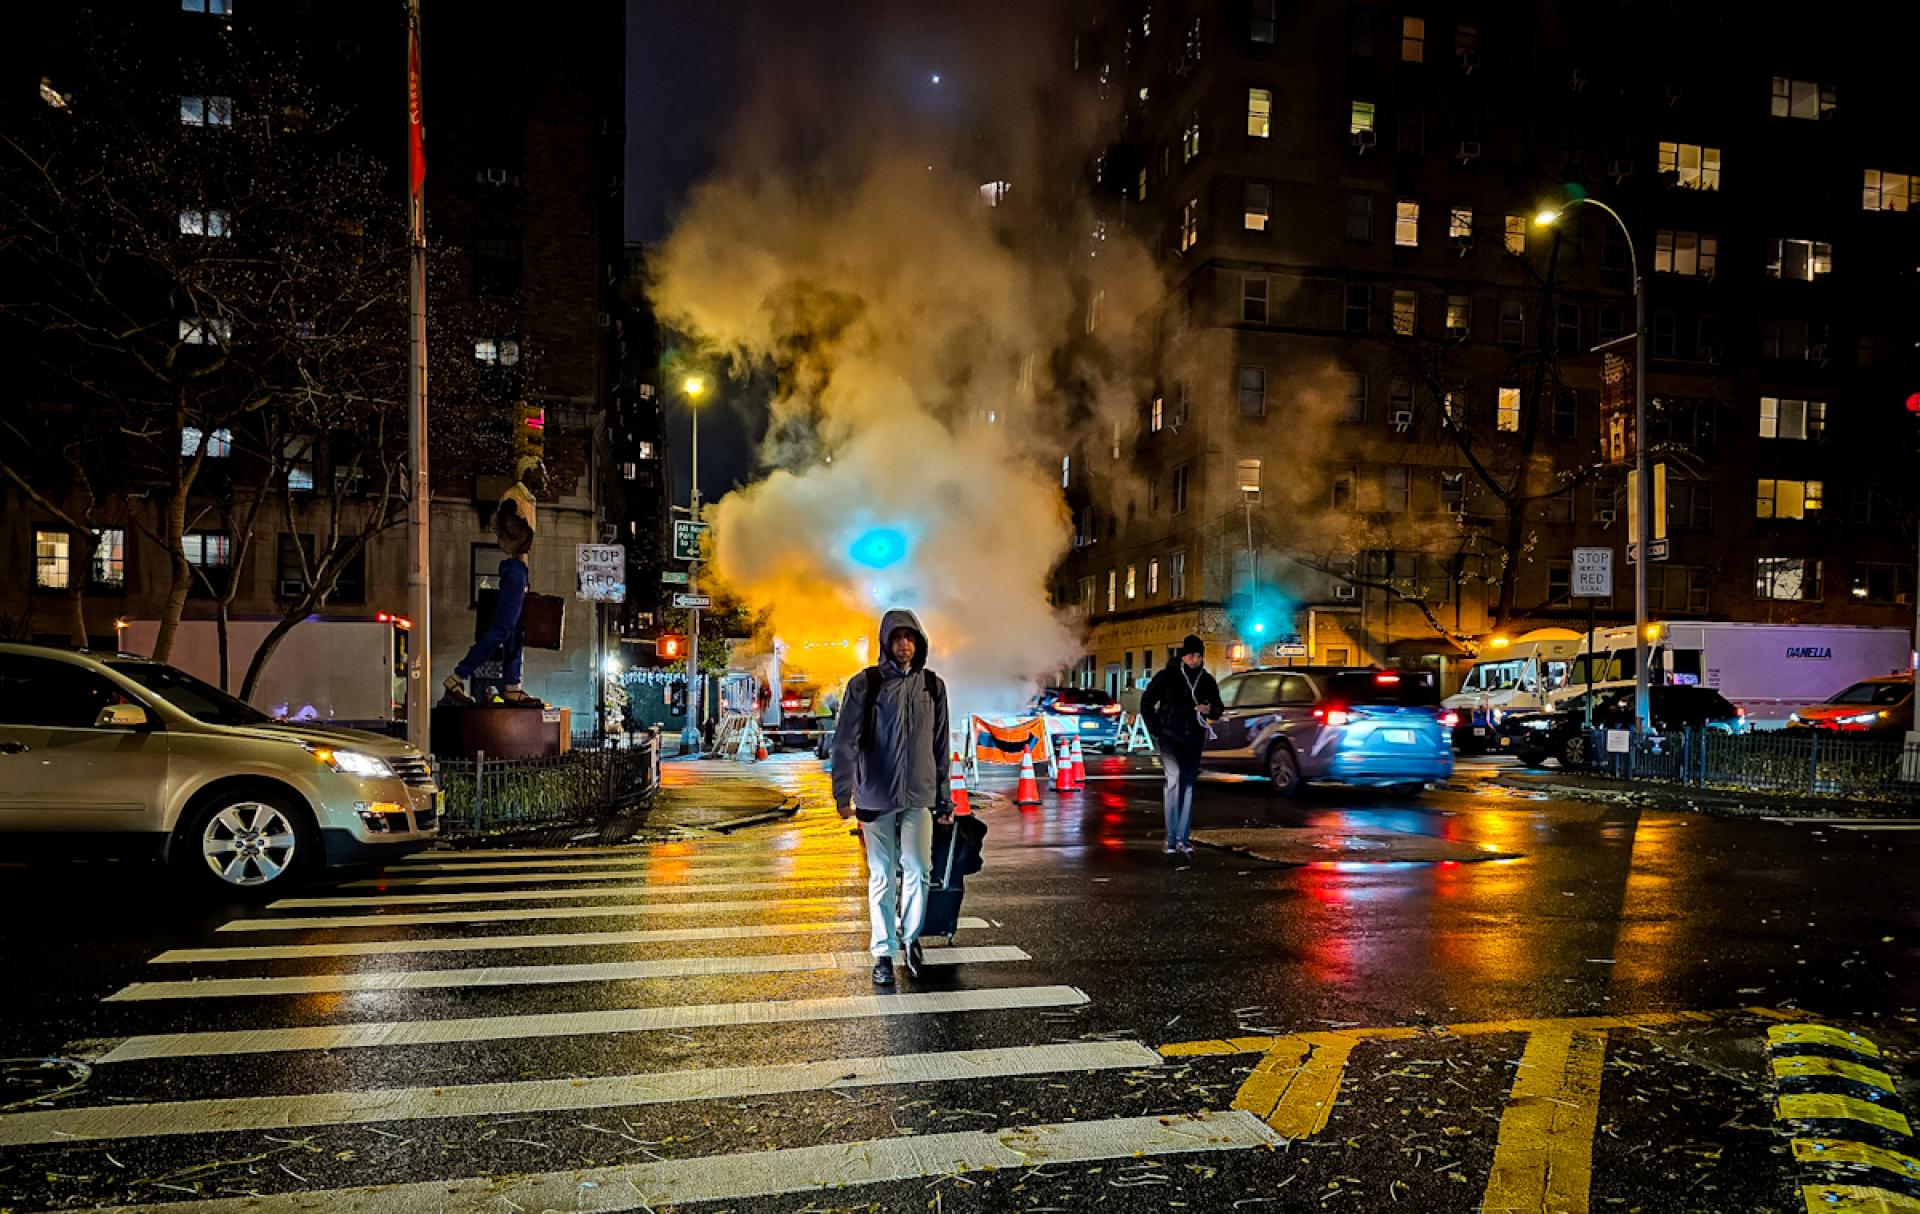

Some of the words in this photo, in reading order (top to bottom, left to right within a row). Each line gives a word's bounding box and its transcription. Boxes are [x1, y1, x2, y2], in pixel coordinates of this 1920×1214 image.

[582, 549, 619, 562] STOP
[1577, 553, 1609, 564] STOP
[1580, 573, 1604, 585] RED
[1785, 647, 1832, 658] DANELLA
